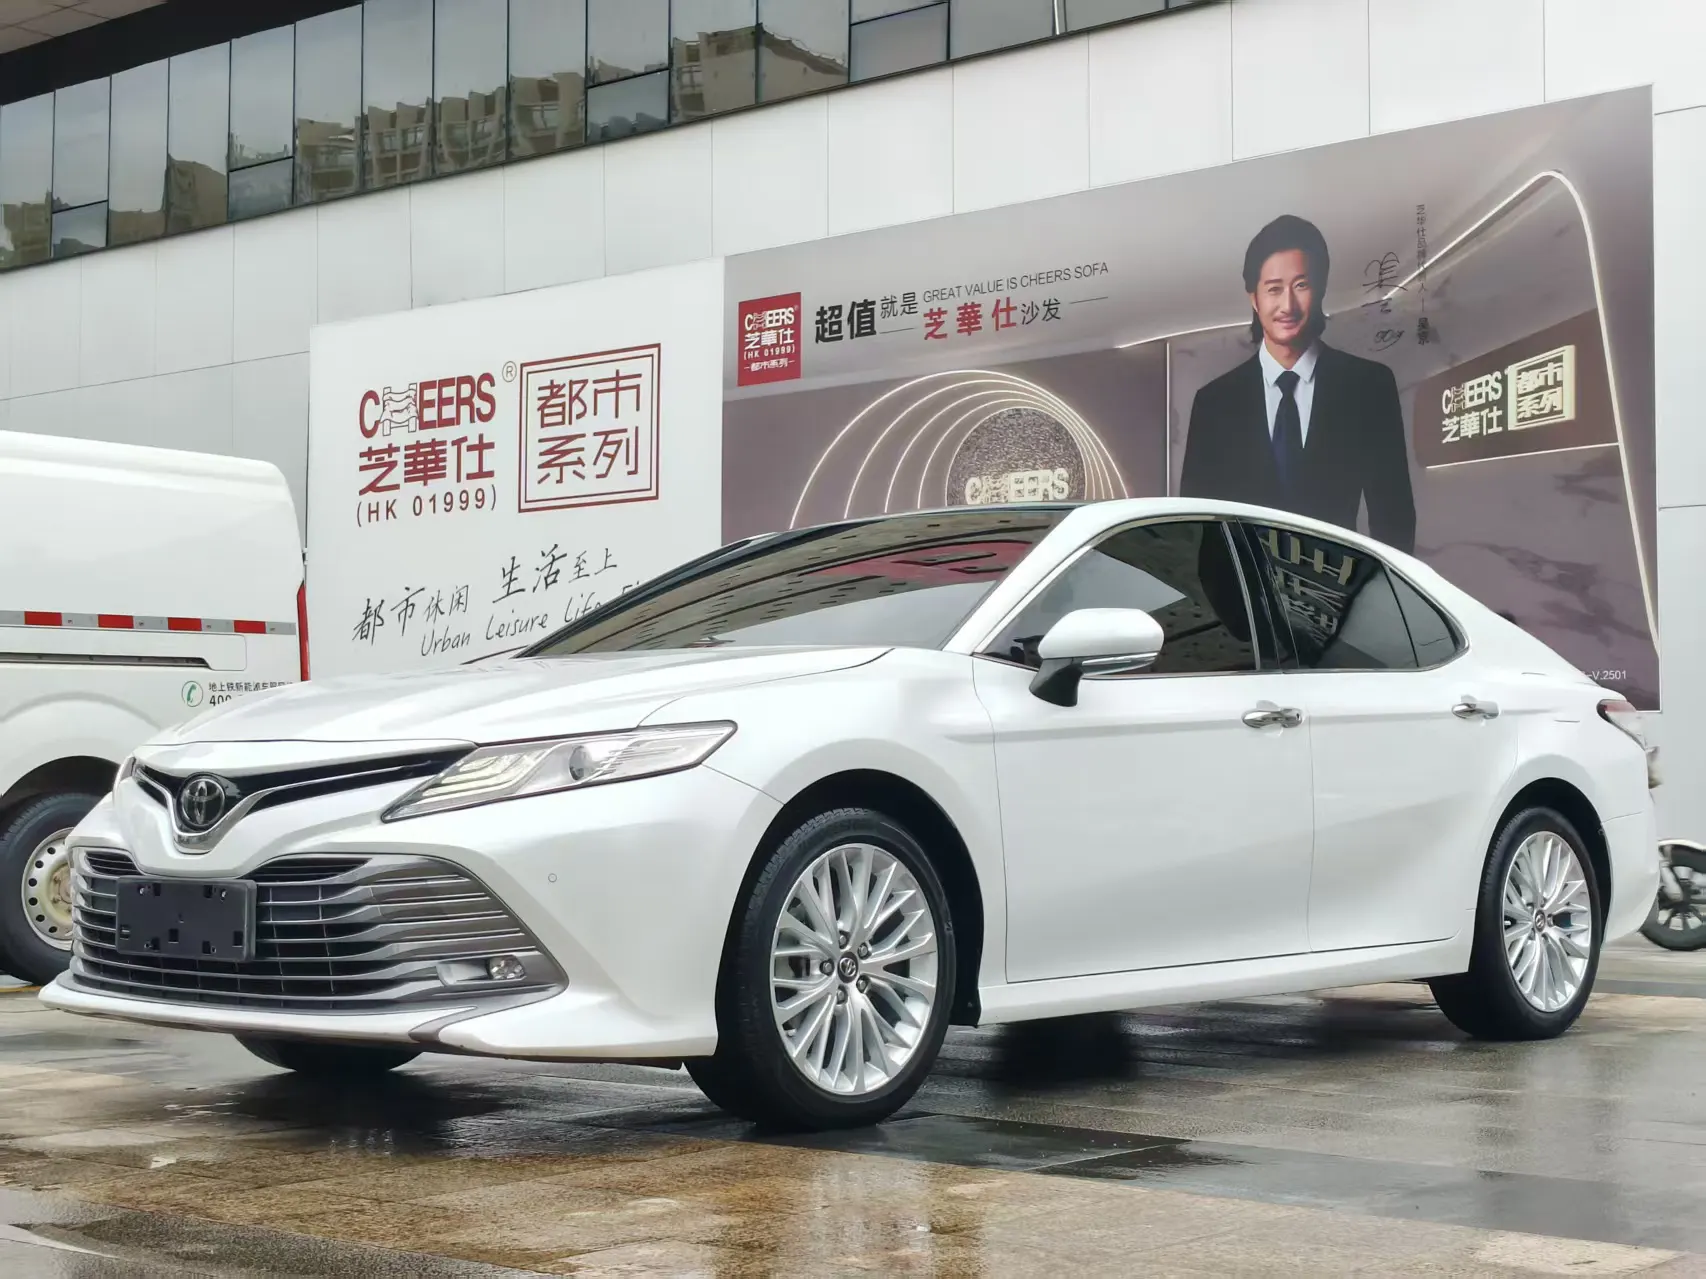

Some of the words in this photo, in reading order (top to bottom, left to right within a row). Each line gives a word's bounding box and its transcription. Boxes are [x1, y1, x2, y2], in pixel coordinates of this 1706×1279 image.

[923, 285, 961, 303] GREAT
[965, 279, 1003, 298] VALUE
[1006, 275, 1018, 291] IS
[1020, 267, 1072, 289] CHEERS
[1074, 261, 1109, 281] SOFA
[745, 307, 794, 331] CHEERS
[745, 328, 794, 350] 芝華仕
[359, 372, 496, 438] CHEERS
[1442, 371, 1502, 415] CHEERS
[1442, 405, 1503, 444] 芝華仕
[359, 433, 495, 496] 芝華仕
[356, 501, 398, 527] (HK
[412, 484, 497, 517] 01999)
[421, 628, 471, 656] Urban
[486, 609, 548, 641] Leisure
